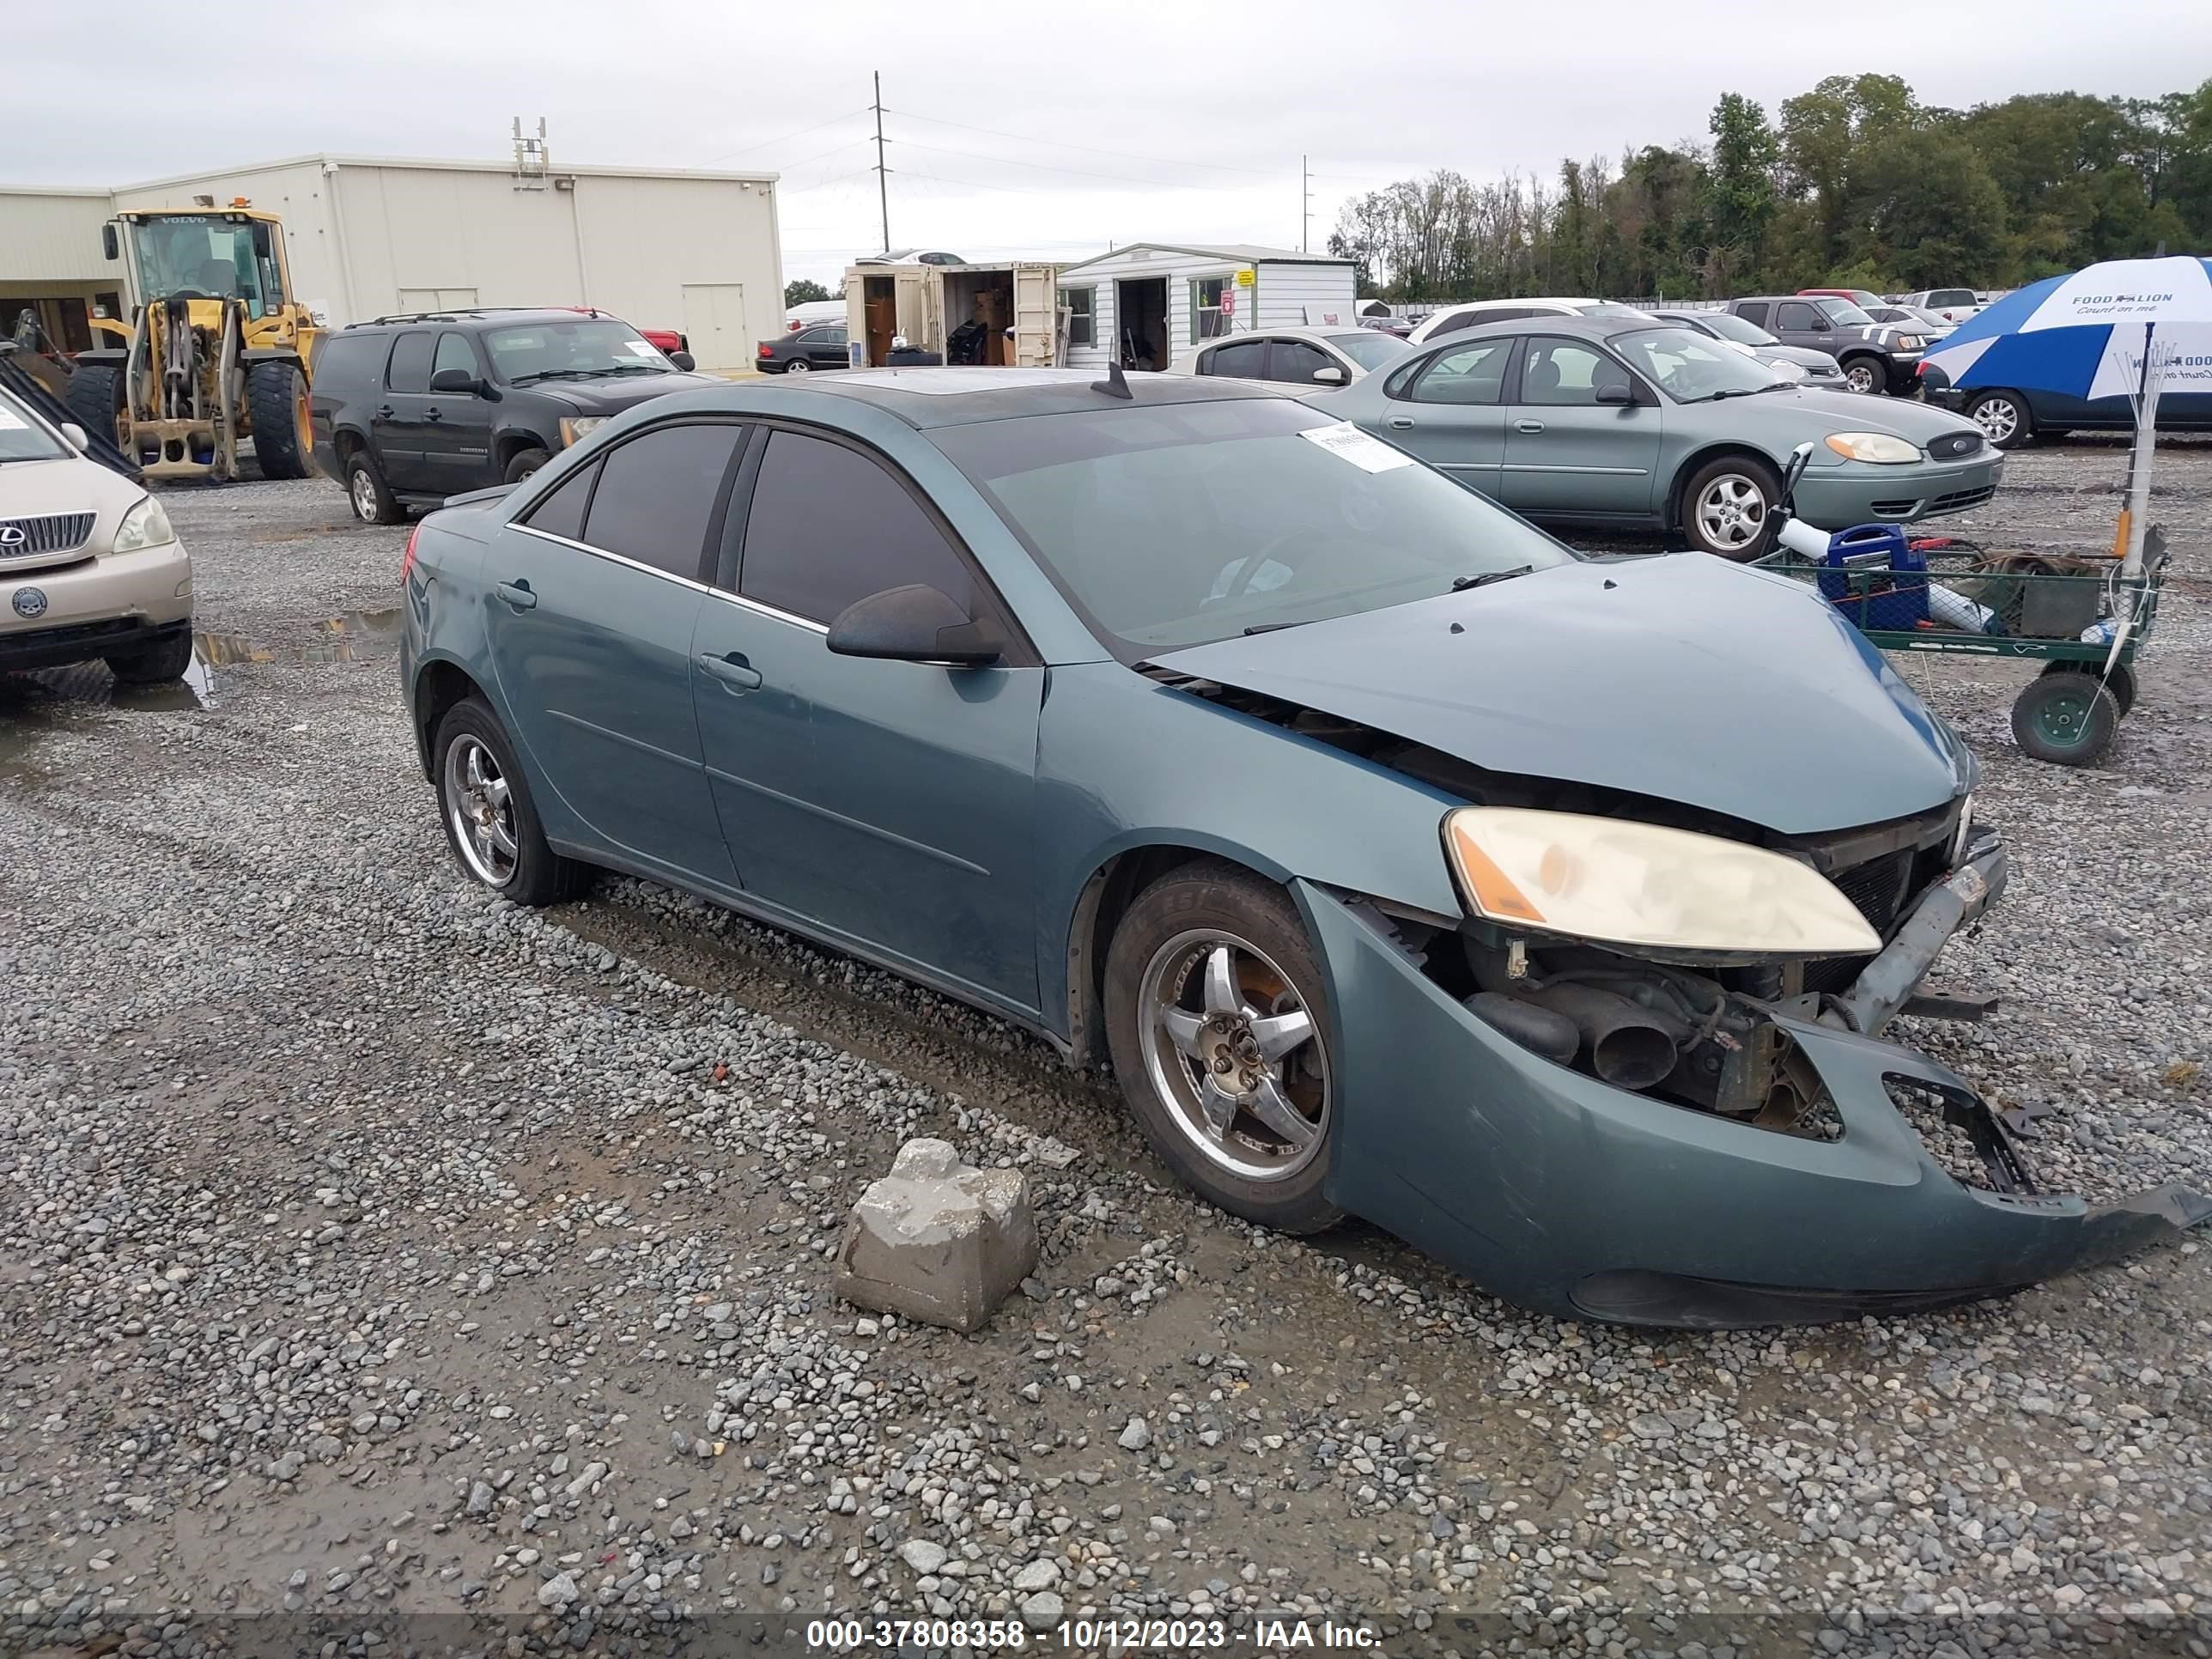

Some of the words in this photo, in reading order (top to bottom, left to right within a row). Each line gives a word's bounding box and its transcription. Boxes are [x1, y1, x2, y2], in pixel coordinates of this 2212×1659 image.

[2072, 295, 2113, 305] FOOD
[2138, 294, 2173, 302] LION
[2076, 305, 2117, 314] Count
